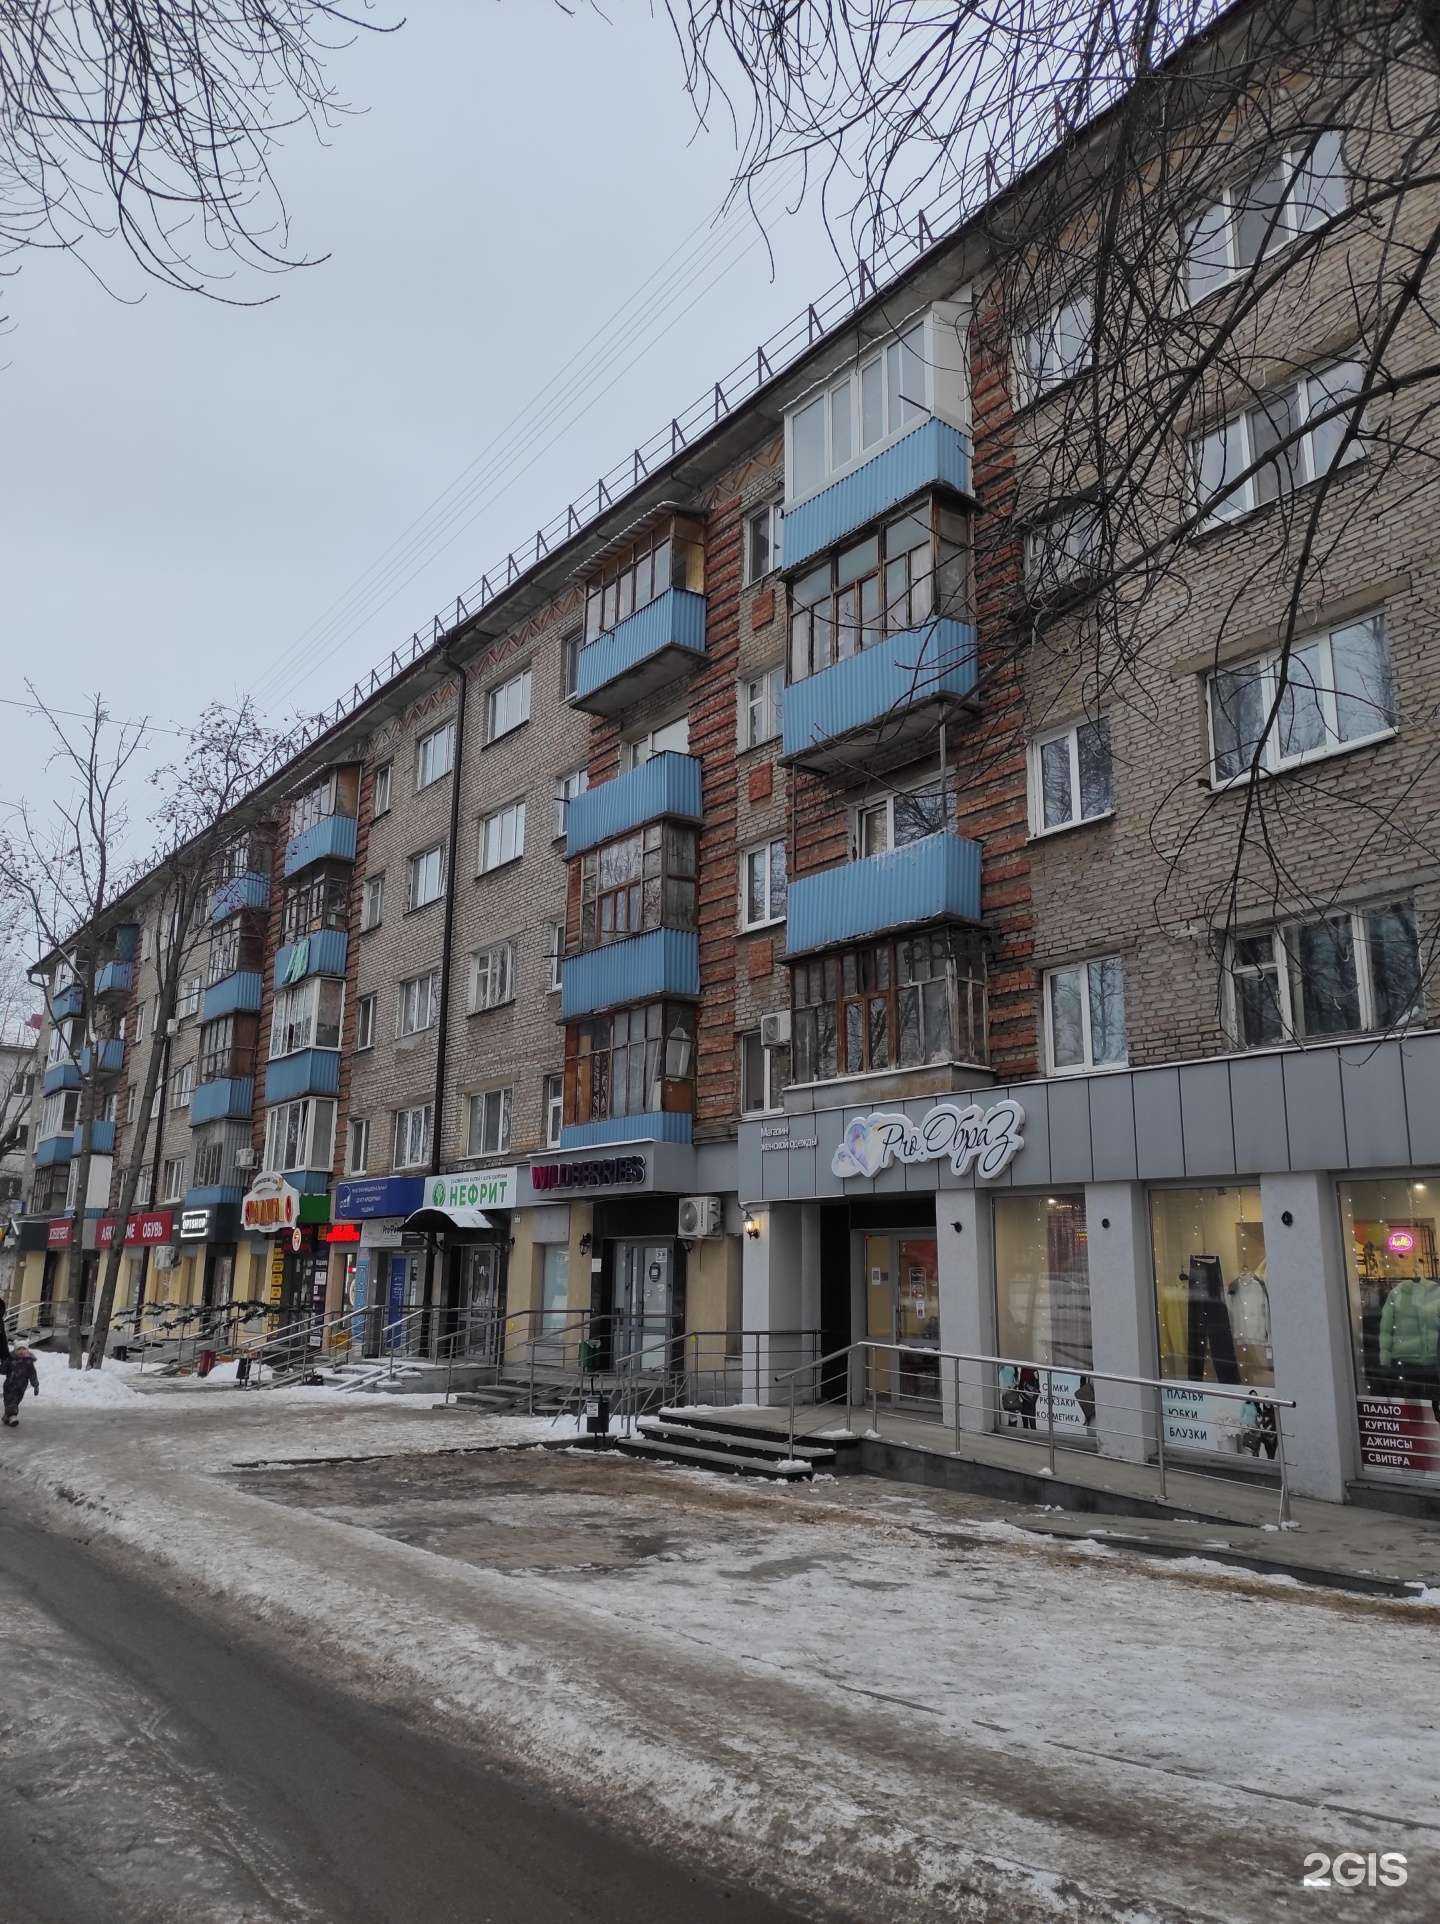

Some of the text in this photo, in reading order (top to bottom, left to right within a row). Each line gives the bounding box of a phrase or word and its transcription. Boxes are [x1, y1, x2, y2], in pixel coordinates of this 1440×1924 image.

[760, 1127, 789, 1138] Магазин
[531, 1154, 646, 1191] WILDBERRIES
[449, 1181, 508, 1207] НЕФРИТ
[142, 1221, 162, 1238] ОБУВЬ
[1041, 1382, 1069, 1393] СМКИ
[1166, 1388, 1204, 1402] ПЛАТЬЯ
[1168, 1408, 1198, 1419] ЮБКИ
[1363, 1404, 1402, 1416] ПАЛЬТО
[1364, 1420, 1400, 1432] КУРТКИ
[1169, 1426, 1207, 1441] БЛУЗКИ
[1366, 1436, 1413, 1449] ДЖИНСЫ
[1368, 1453, 1411, 1466] СВИТЕРА
